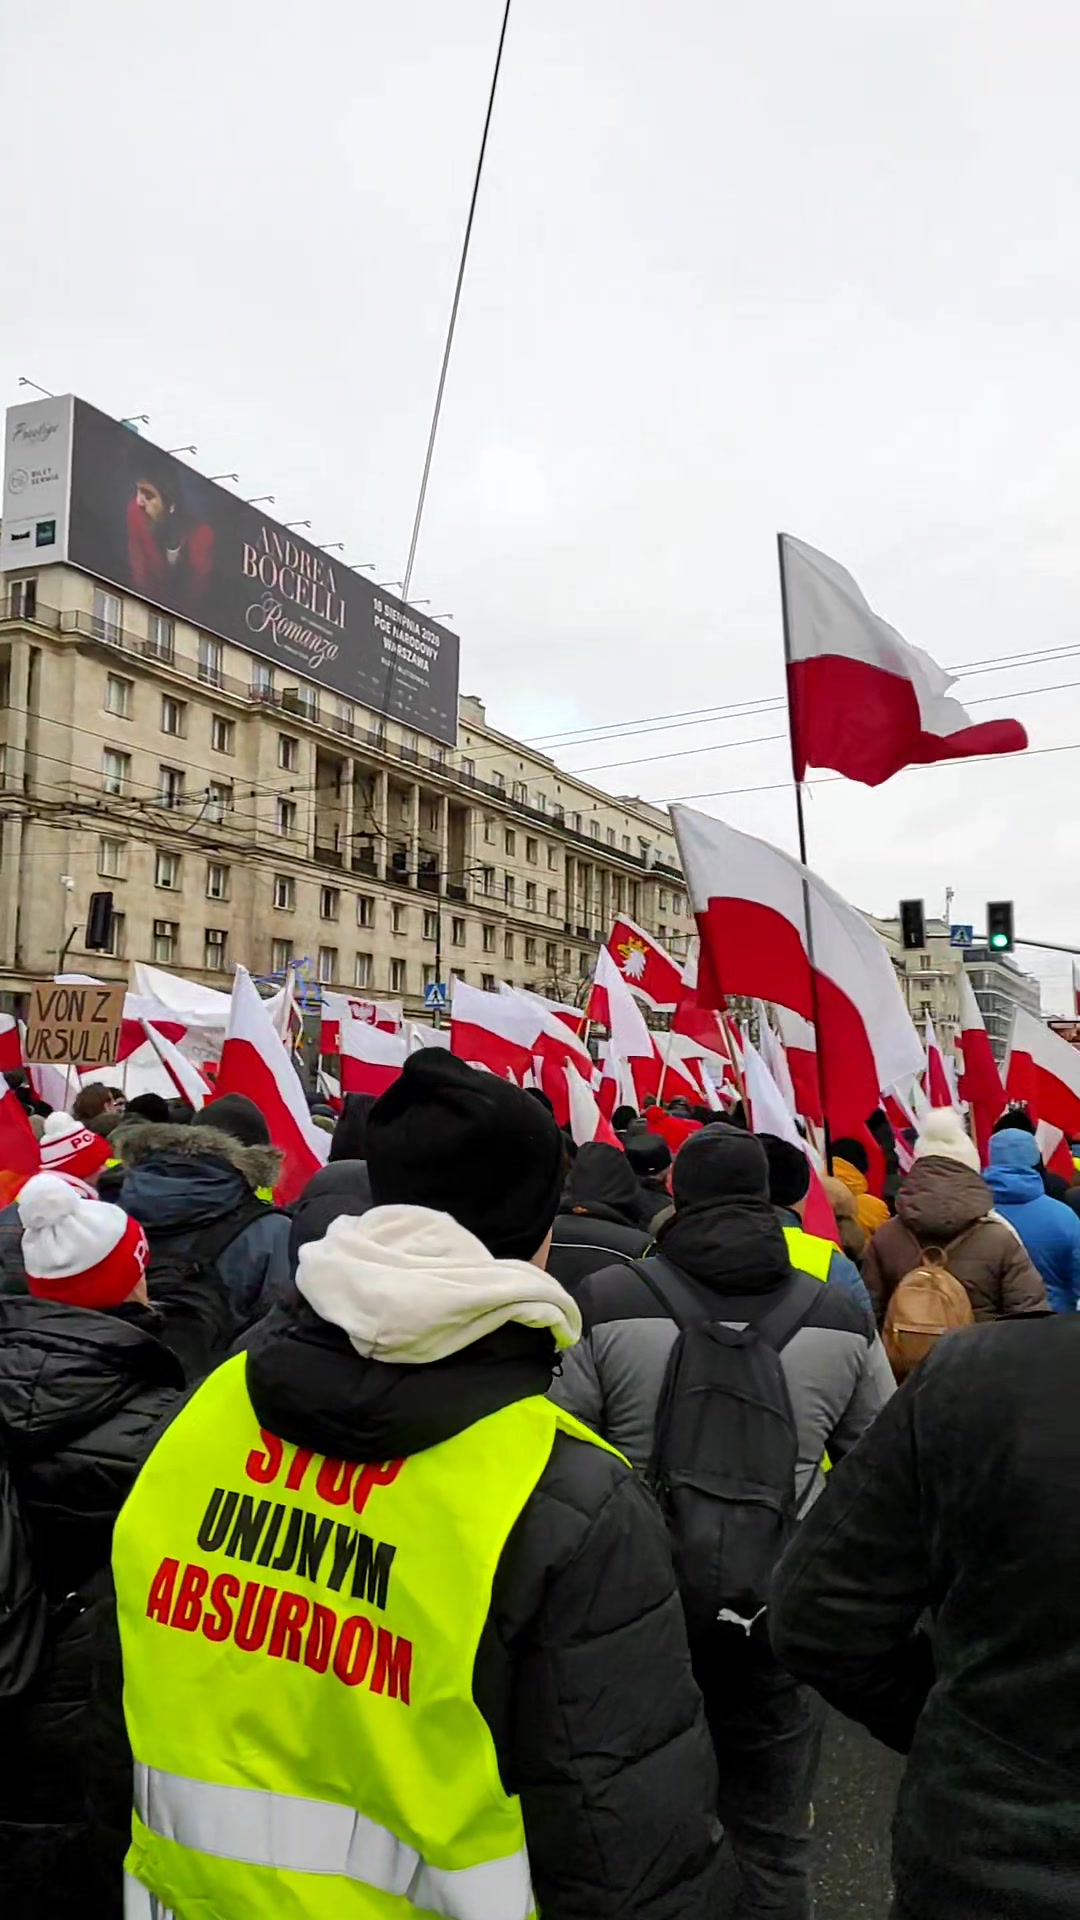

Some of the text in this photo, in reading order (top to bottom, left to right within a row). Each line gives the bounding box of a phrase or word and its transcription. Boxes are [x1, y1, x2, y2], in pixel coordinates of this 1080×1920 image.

[242, 542, 345, 630] BOCELLI
[255, 526, 336, 593] ANDREA
[245, 591, 339, 669] Romanza
[374, 615, 438, 661] PGE NARODOWY
[384, 604, 420, 636] SIERPNIA
[383, 636, 430, 672] WARSZAWA
[36, 989, 111, 1023] VON Z
[26, 1027, 120, 1062] URSULA!
[197, 1487, 397, 1611] UNIJNYM
[146, 1557, 413, 1706] ABSURDOM
